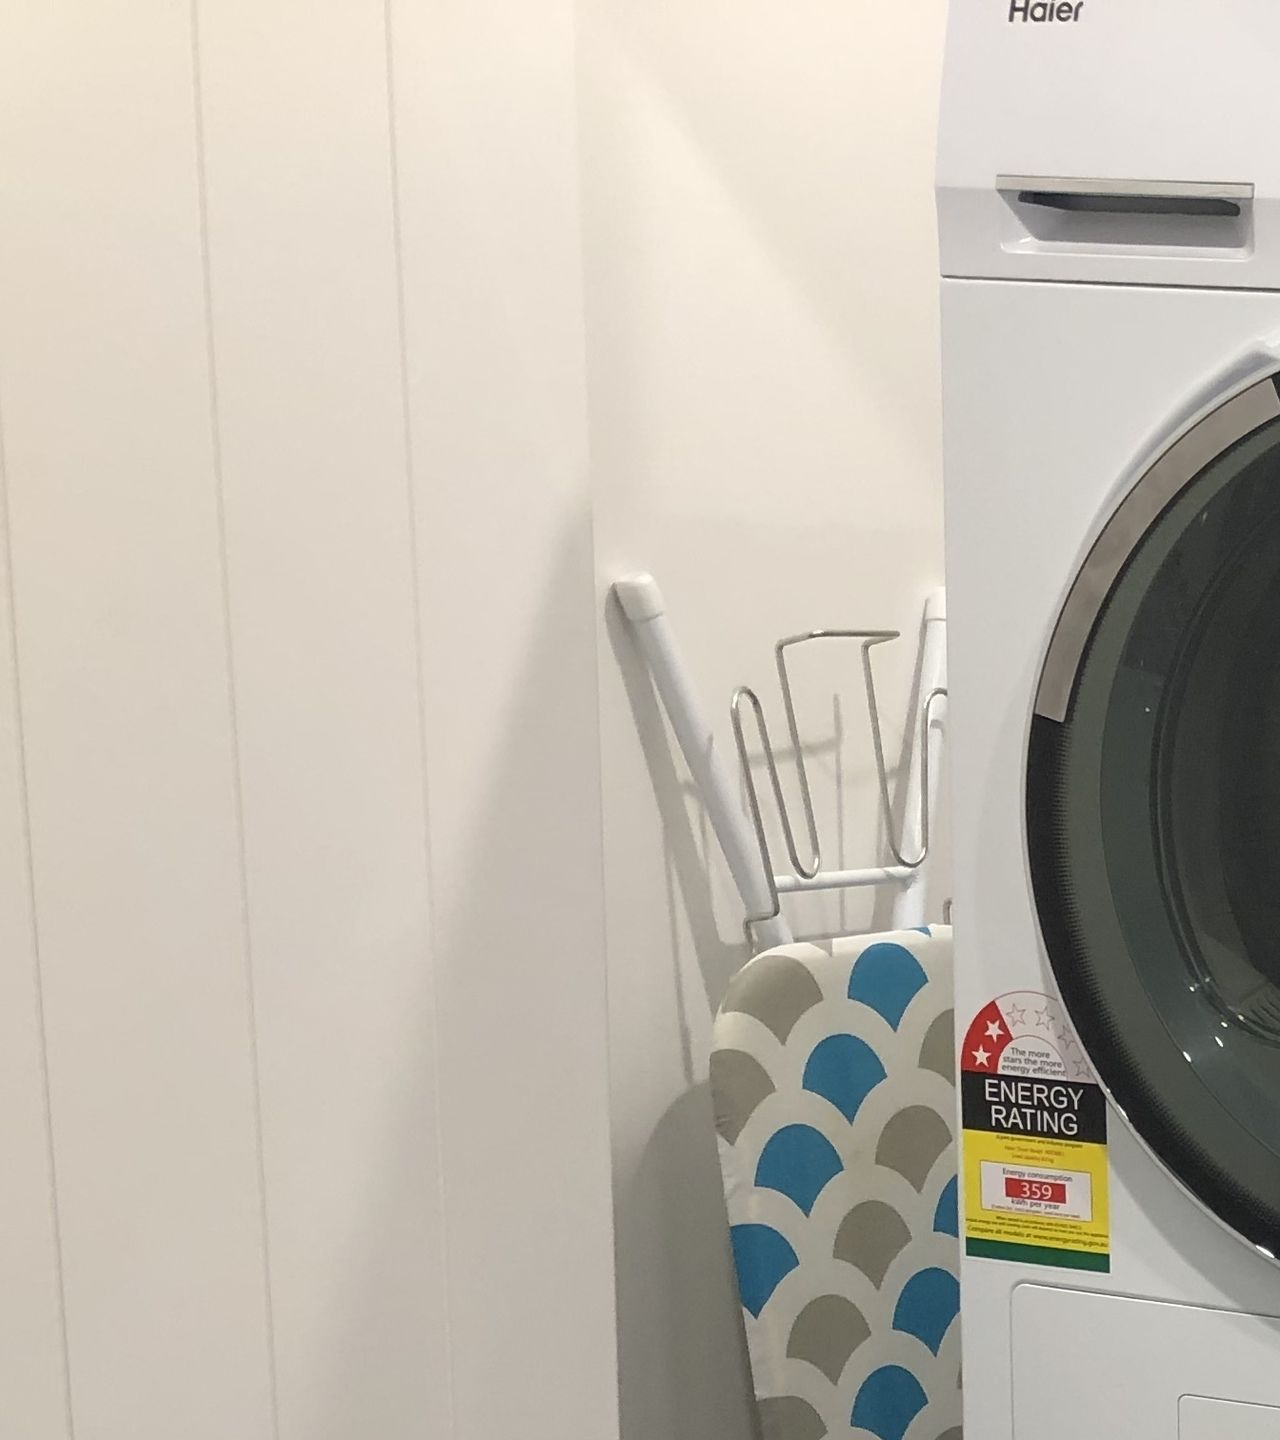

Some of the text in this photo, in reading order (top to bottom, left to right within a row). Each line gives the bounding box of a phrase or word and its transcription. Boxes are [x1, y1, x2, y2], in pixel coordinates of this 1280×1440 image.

[1008, 0, 1084, 22] Haier
[1011, 1047, 1050, 1058] The more
[1003, 1055, 1062, 1068] stars the more
[1002, 1065, 1066, 1077] energy efficient
[985, 1079, 1083, 1110] ENERGY
[991, 1105, 1078, 1135] RATING
[1003, 1168, 1073, 1182] Energy consumption
[1020, 1182, 1052, 1199] 359
